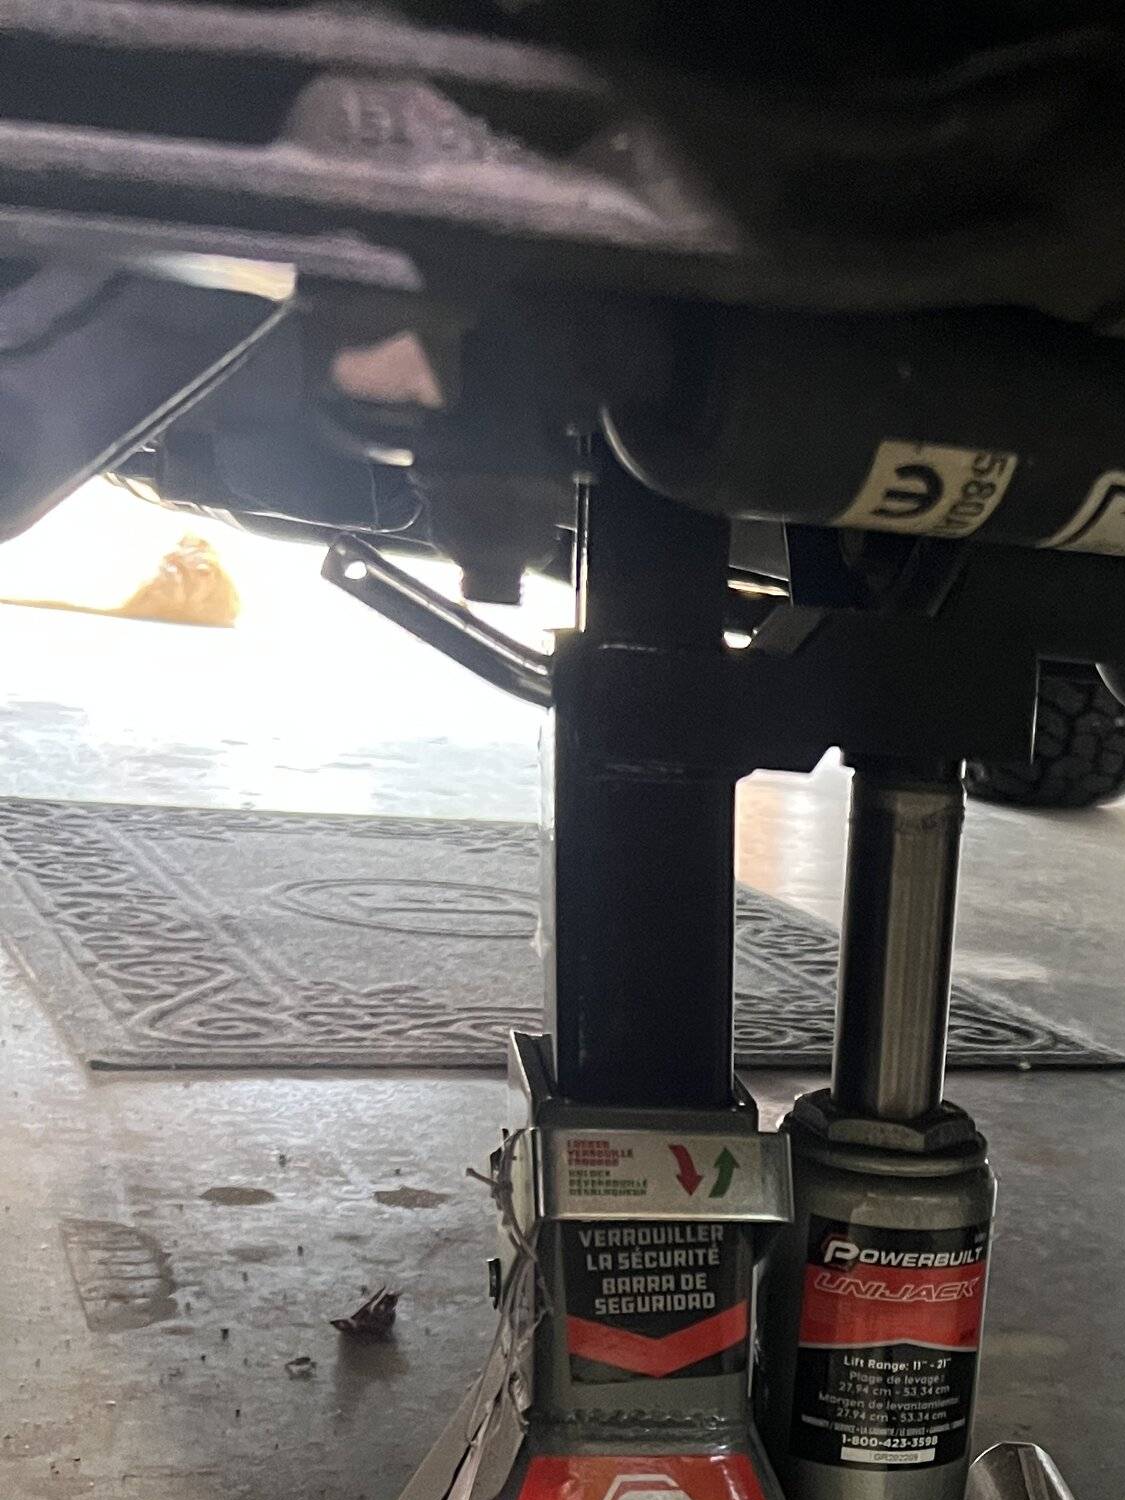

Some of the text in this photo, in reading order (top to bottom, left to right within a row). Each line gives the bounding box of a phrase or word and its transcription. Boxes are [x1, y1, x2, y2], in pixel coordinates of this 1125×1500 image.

[579, 1224, 724, 1248] VERROUILLER
[586, 1245, 720, 1271] LA SÉCURITÉ
[602, 1273, 708, 1295] BARRA DE
[814, 1272, 983, 1303] UNIJACK
[594, 1292, 716, 1315] SEGURIDAD
[843, 1355, 864, 1368] Lift
[868, 1358, 909, 1373] Range:
[849, 1371, 883, 1385] Plage
[886, 1376, 901, 1385] de
[839, 1381, 869, 1395] 27.94
[873, 1388, 892, 1396] cm
[903, 1386, 933, 1397] 53.34
[935, 1384, 950, 1394] cm
[836, 1407, 866, 1420] 27.94
[870, 1413, 888, 1422] cm
[900, 1412, 930, 1422] 53.34
[932, 1410, 947, 1420] cm
[868, 1400, 884, 1410] de
